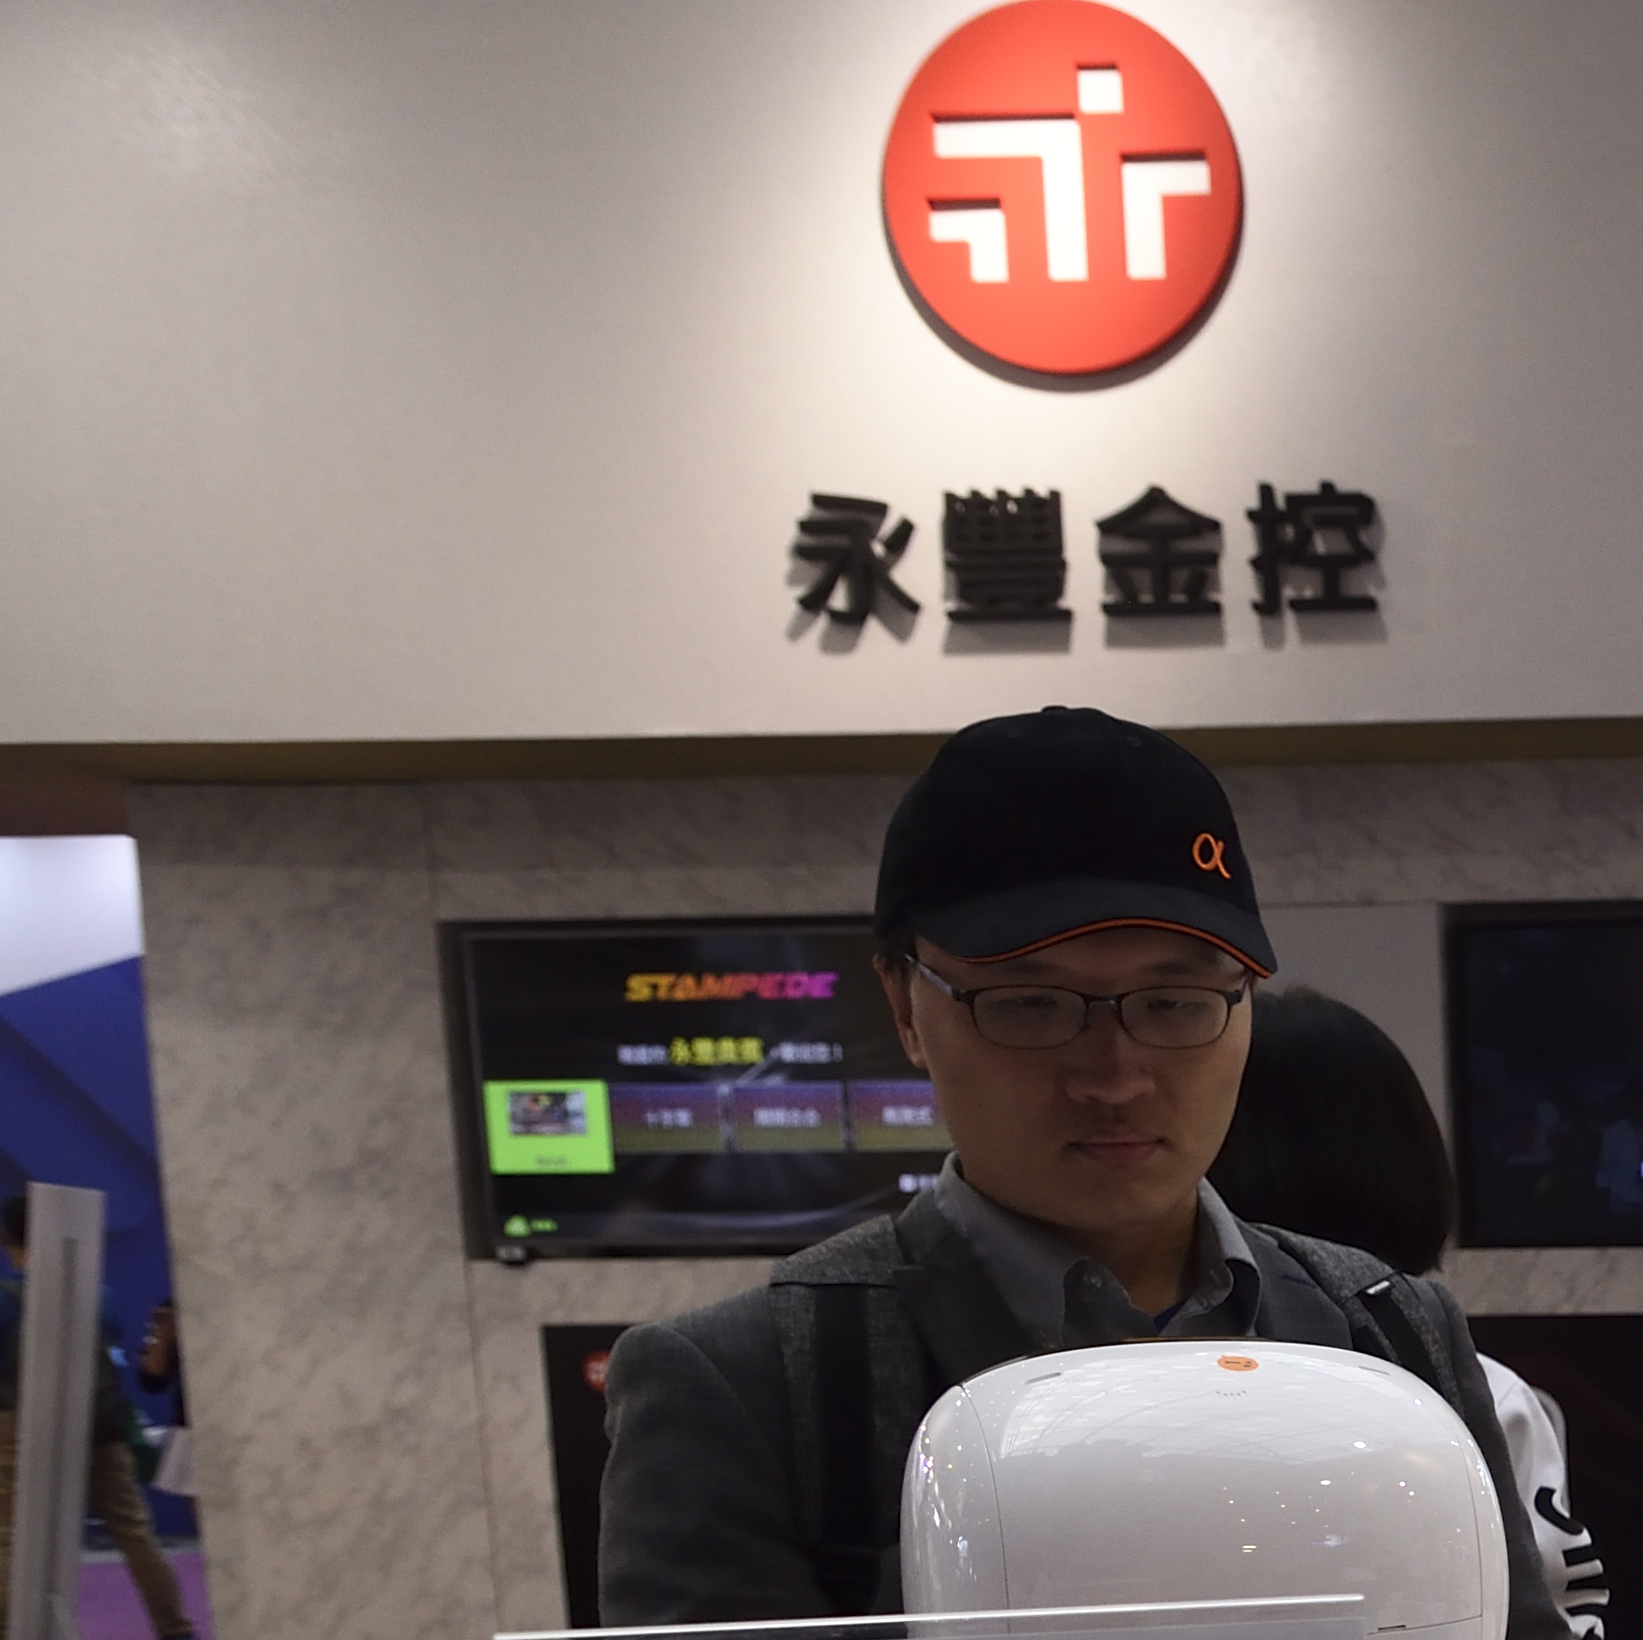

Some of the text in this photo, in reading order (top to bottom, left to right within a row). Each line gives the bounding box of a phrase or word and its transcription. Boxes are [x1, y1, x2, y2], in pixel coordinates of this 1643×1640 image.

[797, 481, 1379, 626] 永豐金控
[625, 971, 839, 1001] STAMPEDE
